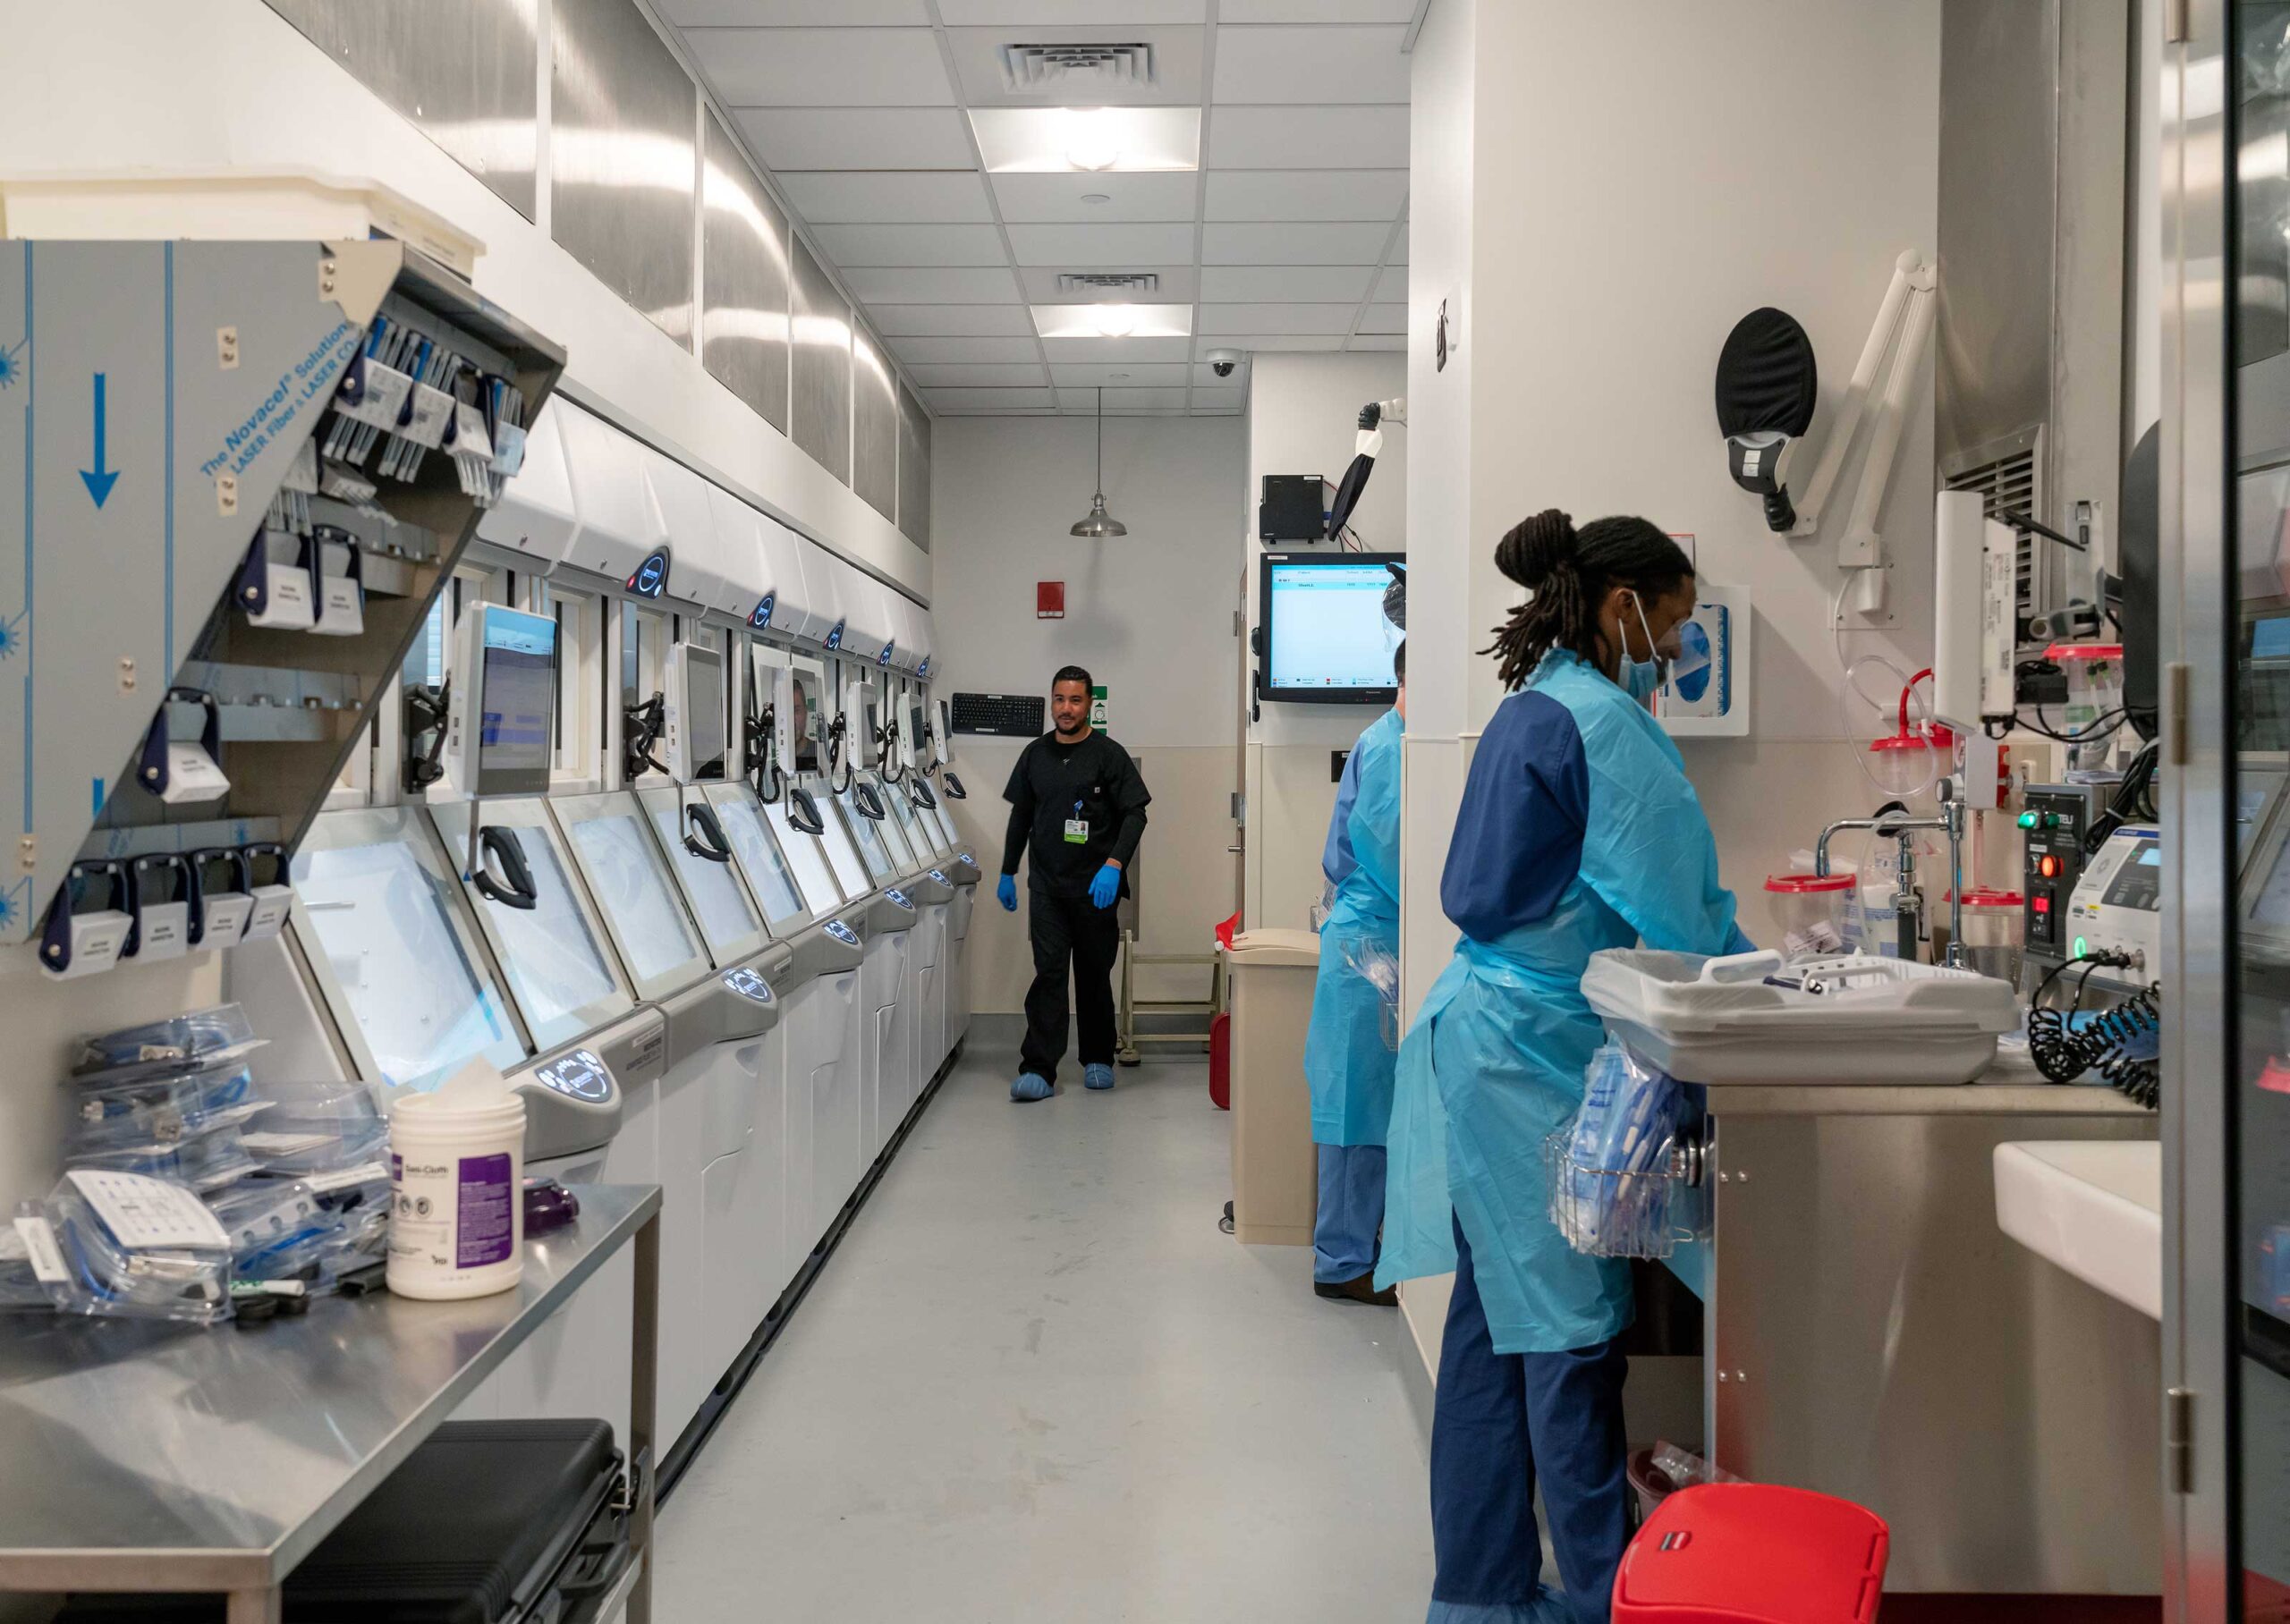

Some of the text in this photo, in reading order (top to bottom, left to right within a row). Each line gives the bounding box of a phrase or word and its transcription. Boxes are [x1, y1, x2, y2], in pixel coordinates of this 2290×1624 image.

[230, 434, 269, 476] LASER
[267, 404, 295, 436] Fiber
[301, 359, 338, 399] LASER
[200, 451, 228, 477] The
